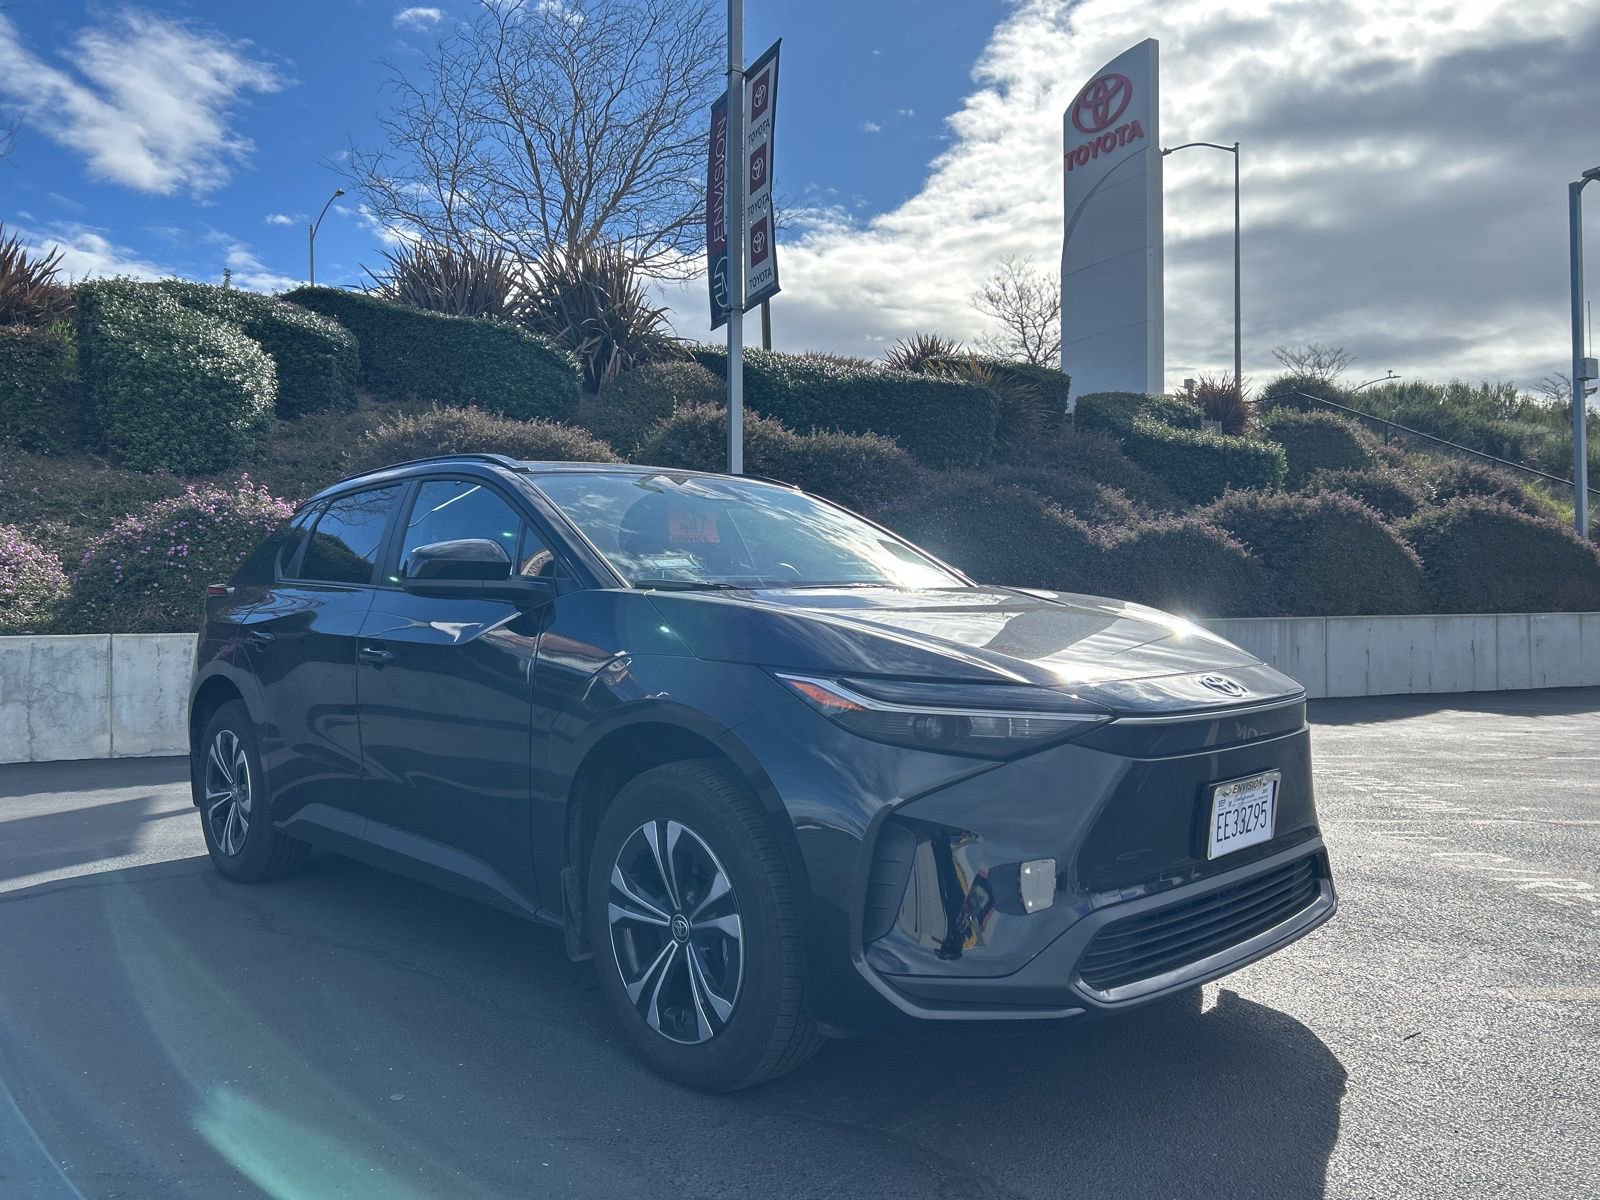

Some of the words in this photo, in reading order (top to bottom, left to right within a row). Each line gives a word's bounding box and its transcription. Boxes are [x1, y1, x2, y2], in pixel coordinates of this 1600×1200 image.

[747, 118, 770, 144] TOYOTA
[1064, 119, 1145, 171] TOYOTA
[713, 115, 727, 242] ENVISION
[747, 192, 770, 216] TOYOTA
[748, 267, 773, 290] TOYOTA
[1232, 778, 1264, 794] ENVISION
[1216, 800, 1268, 843] EE33Z95
